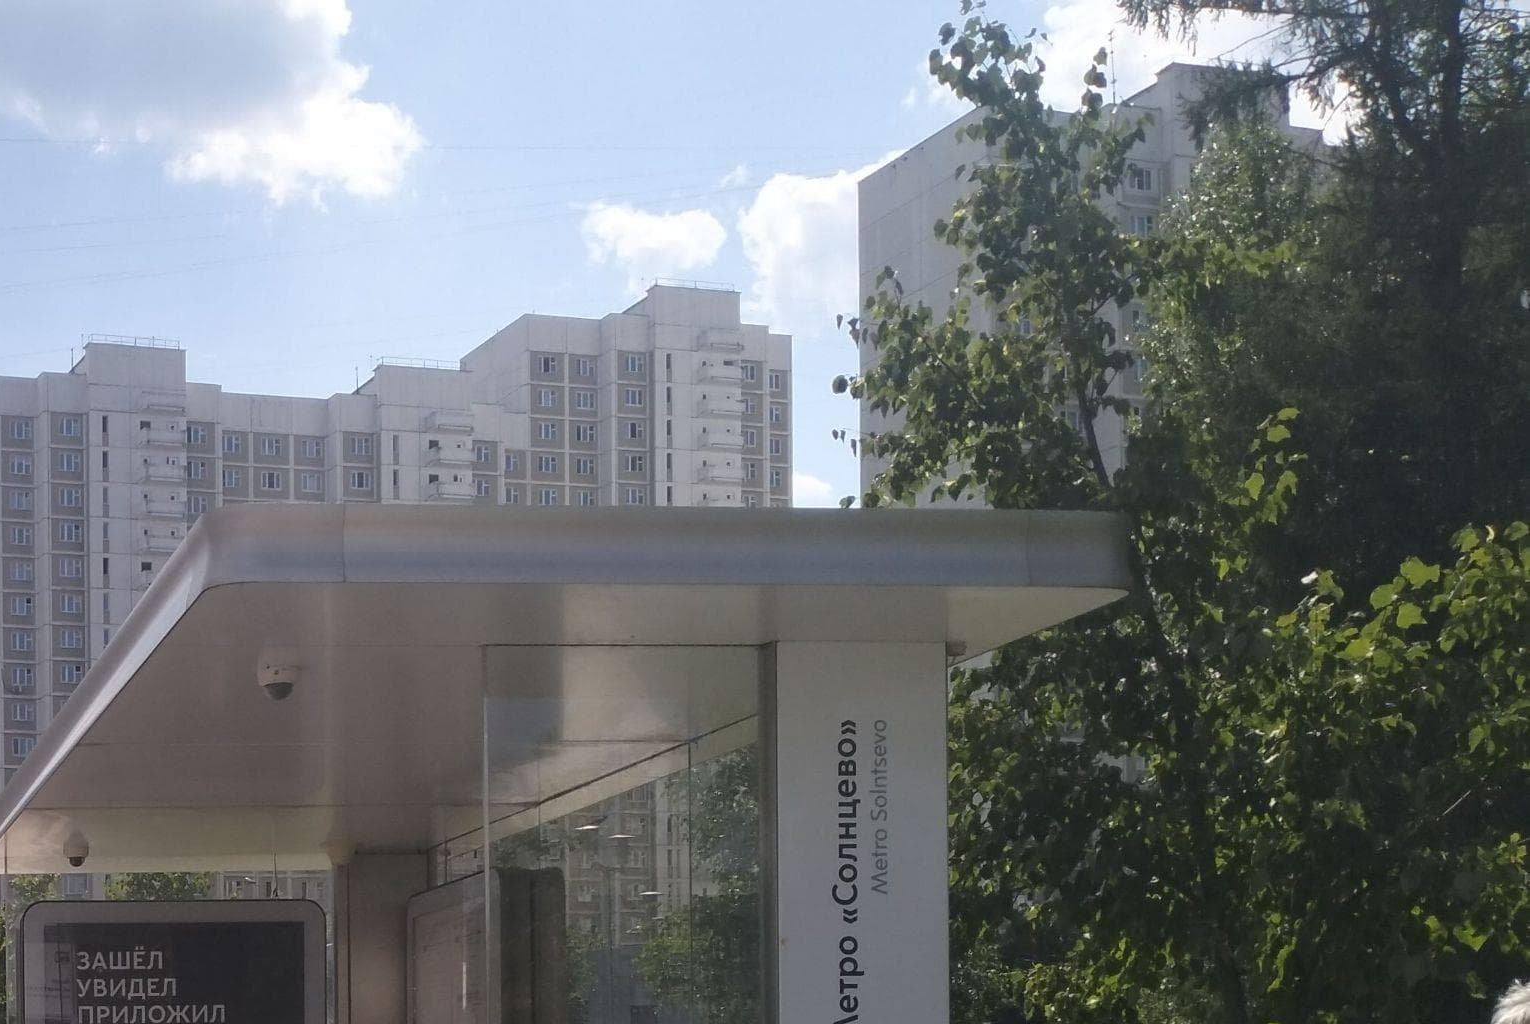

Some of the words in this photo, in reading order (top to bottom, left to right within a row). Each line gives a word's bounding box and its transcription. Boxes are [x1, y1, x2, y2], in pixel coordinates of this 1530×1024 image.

[869, 719, 888, 821] Solntsevo
[832, 719, 861, 924] «Солнцево»
[871, 826, 888, 895] Metro
[76, 946, 163, 970] ЗАШЁЛ
[77, 978, 177, 1000] УВИДЕЛ
[78, 1004, 226, 1024] ПРИЛОЖИЛ
